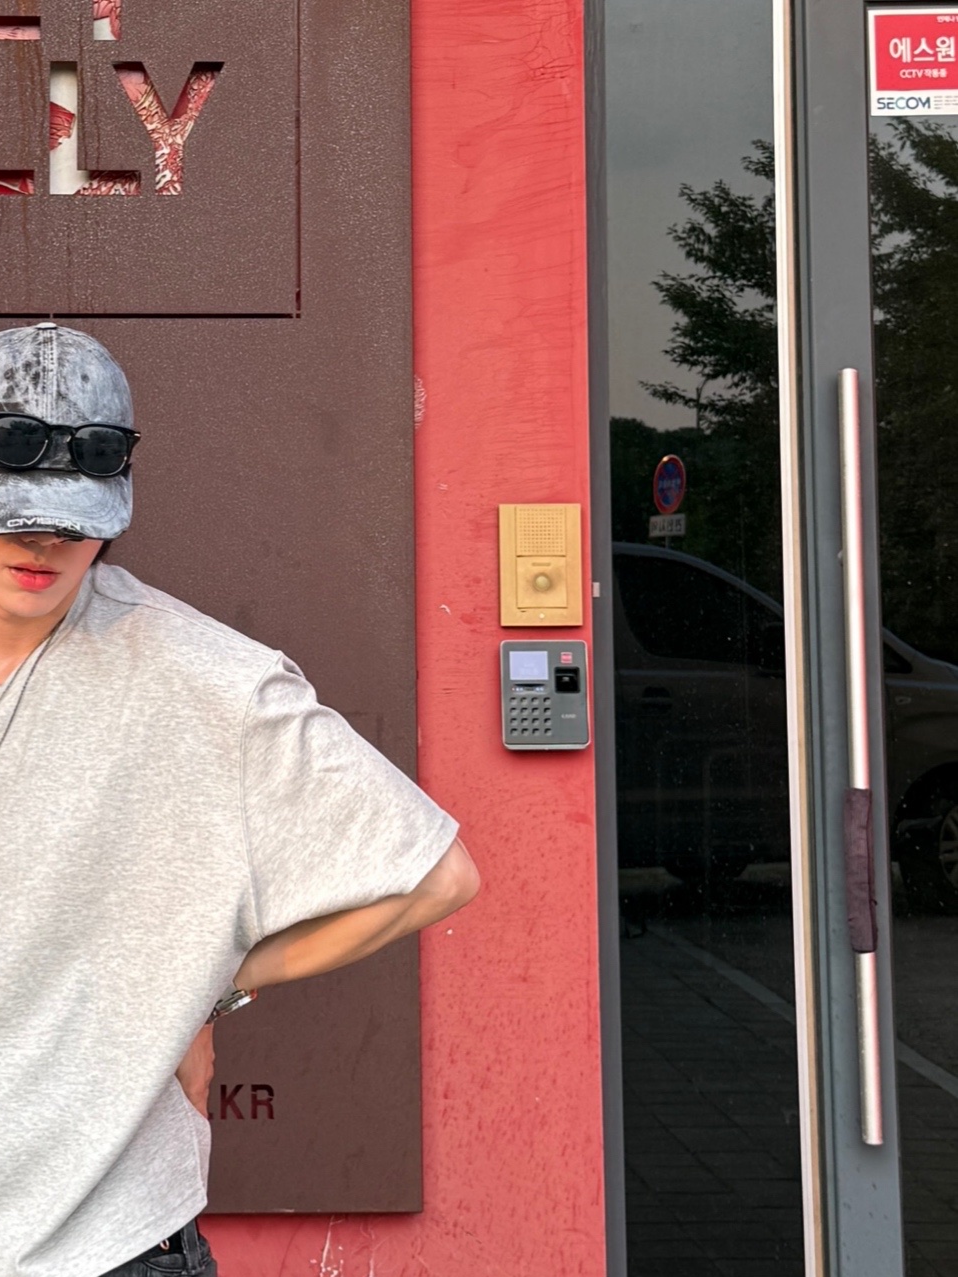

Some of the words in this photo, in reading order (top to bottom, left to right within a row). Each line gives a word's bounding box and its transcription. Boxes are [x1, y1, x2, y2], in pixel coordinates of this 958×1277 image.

[889, 36, 956, 63] 에스원
[899, 68, 923, 79] CCTV
[877, 96, 931, 110] SECOM
